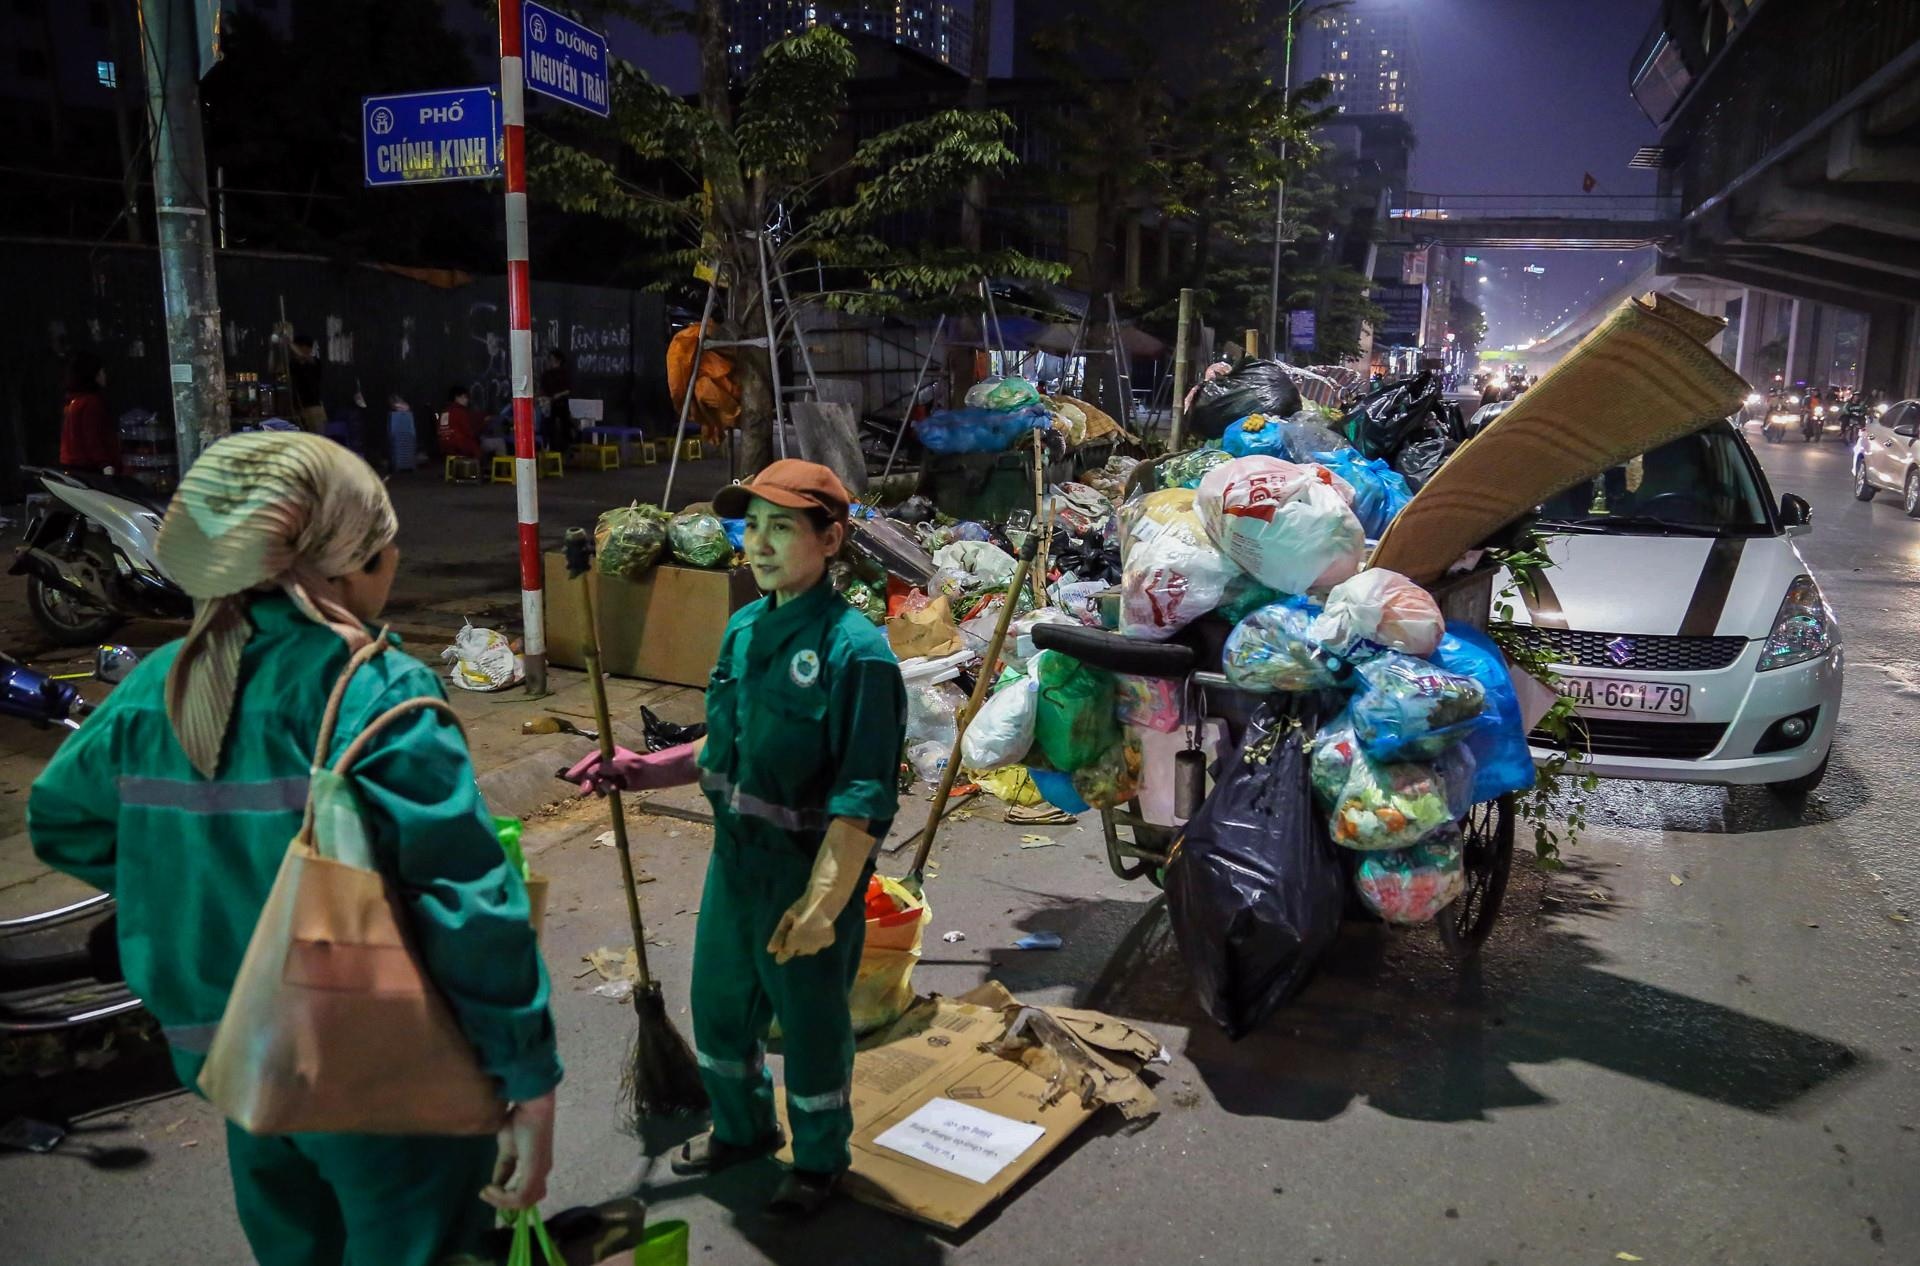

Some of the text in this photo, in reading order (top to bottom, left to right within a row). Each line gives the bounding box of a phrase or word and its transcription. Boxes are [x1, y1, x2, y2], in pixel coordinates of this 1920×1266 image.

[555, 28, 598, 60] ĐƯỜNG
[530, 50, 605, 106] NGUYỄN TRÃI
[419, 98, 465, 125] PHỐ
[377, 137, 487, 173] CHÍNH KINH
